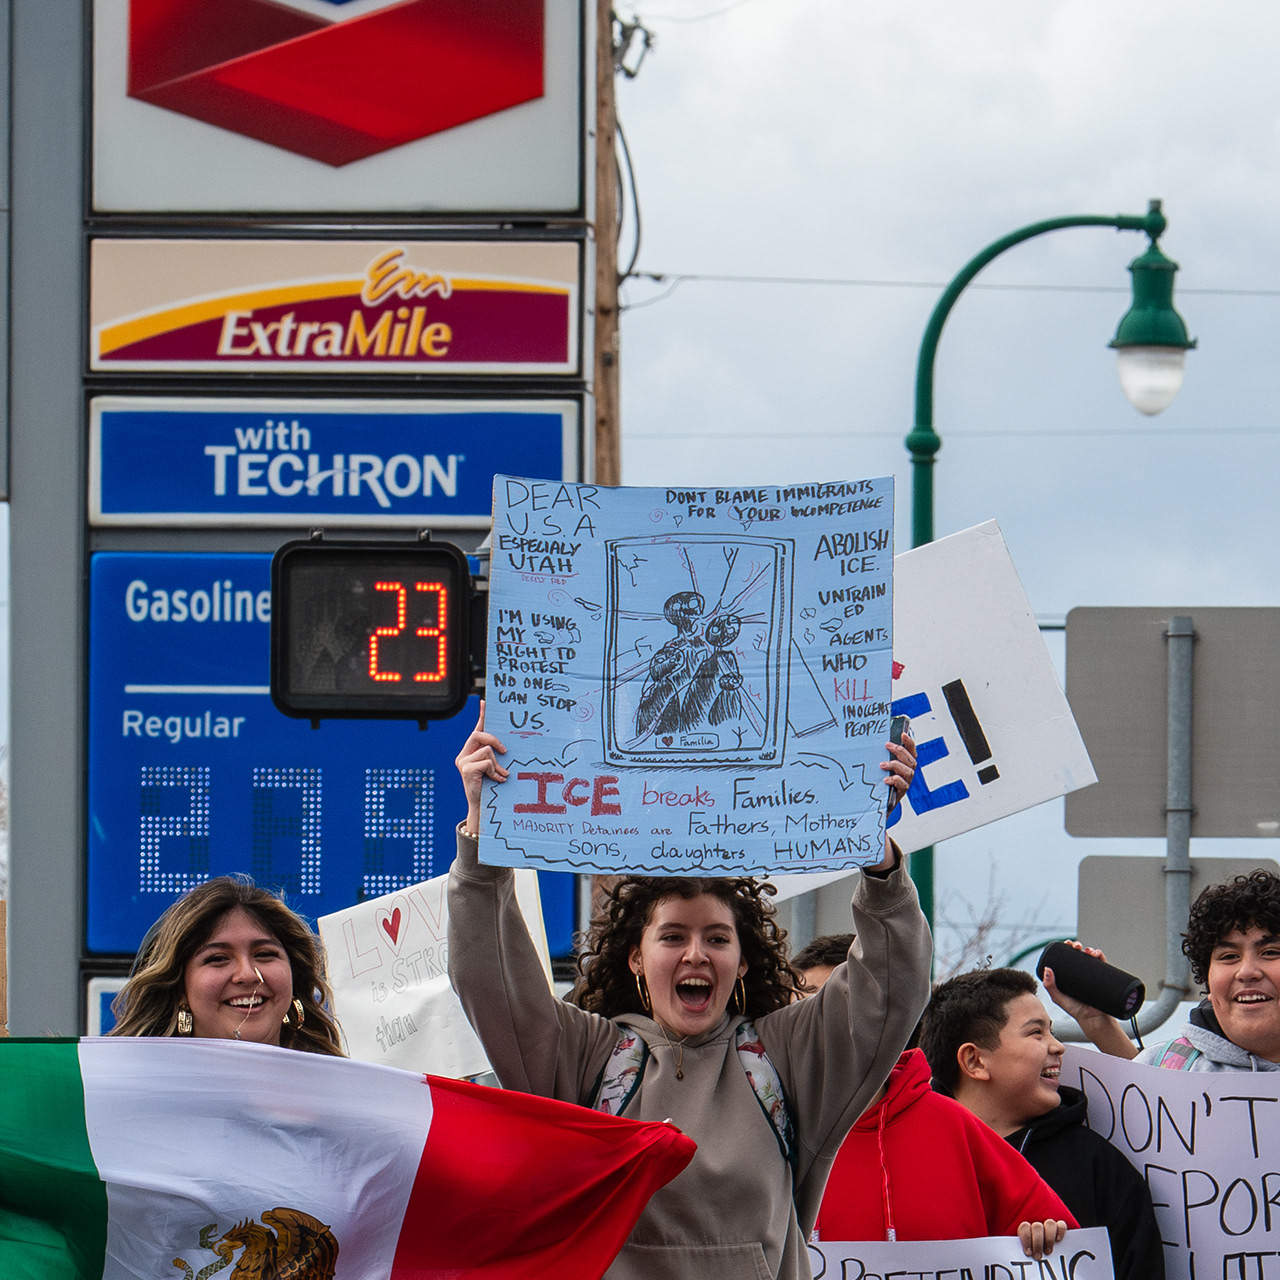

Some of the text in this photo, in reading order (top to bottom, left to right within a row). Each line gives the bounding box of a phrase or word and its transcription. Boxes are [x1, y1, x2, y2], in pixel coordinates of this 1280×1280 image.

[218, 307, 451, 357] ExtraMile
[235, 421, 310, 450] with
[505, 480, 601, 511] DEAR
[665, 480, 874, 504] DONT BLAME IMMIGRANTS
[688, 505, 716, 518] FOR
[733, 505, 781, 521] YOUR
[814, 528, 889, 561] ABOLISH
[508, 553, 573, 574] UTAH
[125, 580, 271, 622] Gasoline
[818, 582, 886, 606] UNTRAIN
[498, 609, 576, 630] I'M USING
[844, 604, 864, 618] ED
[369, 582, 447, 682] 23
[496, 626, 526, 642] MY
[496, 643, 576, 660] RIGHT TO
[822, 654, 868, 673] WHO
[497, 656, 569, 673] PROTEST
[523, 677, 554, 690] ONE
[833, 677, 873, 702] KILL
[498, 690, 577, 712] CAN STOP
[122, 711, 245, 743] Regular
[680, 736, 714, 747] Familia
[513, 771, 622, 816] ICE
[642, 780, 715, 807] breaks
[513, 819, 575, 835] MAJORITY
[651, 827, 673, 836] are
[785, 812, 857, 833] Mothers
[376, 1013, 418, 1052] than
[1079, 1066, 1278, 1159] DON'T
